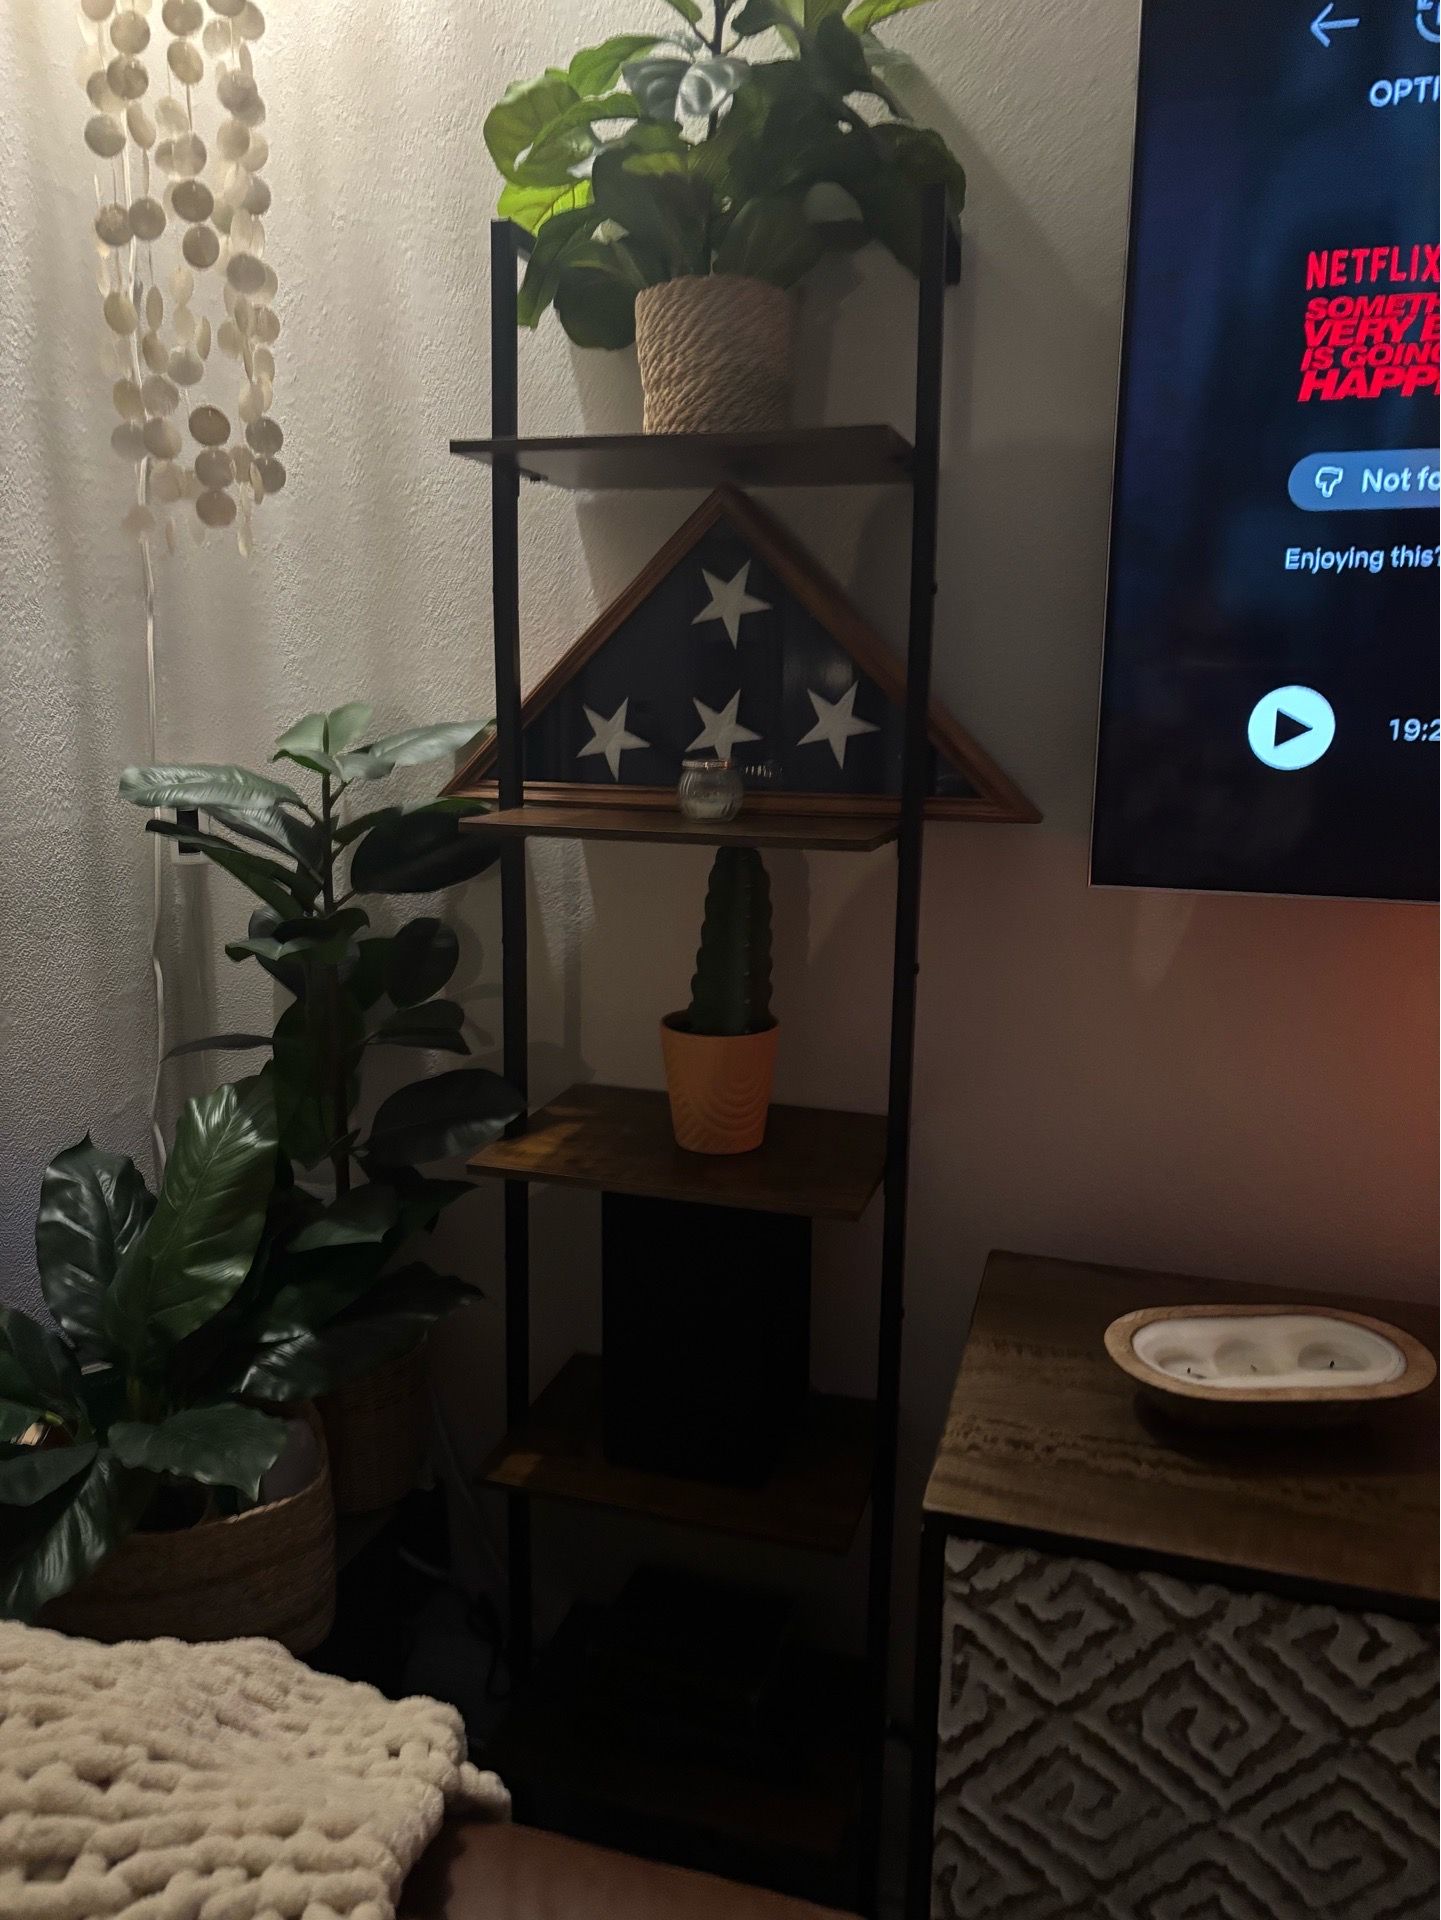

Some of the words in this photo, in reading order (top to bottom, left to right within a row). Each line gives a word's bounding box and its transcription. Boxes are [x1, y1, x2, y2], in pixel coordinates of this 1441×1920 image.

[1369, 75, 1440, 108] OPTI
[1306, 244, 1440, 291] NETFLIX
[1304, 315, 1417, 347] VERY
[1301, 346, 1335, 371] IS
[1298, 366, 1440, 402] HAPP
[1361, 467, 1412, 493] Not
[1285, 546, 1385, 574] Enjoying
